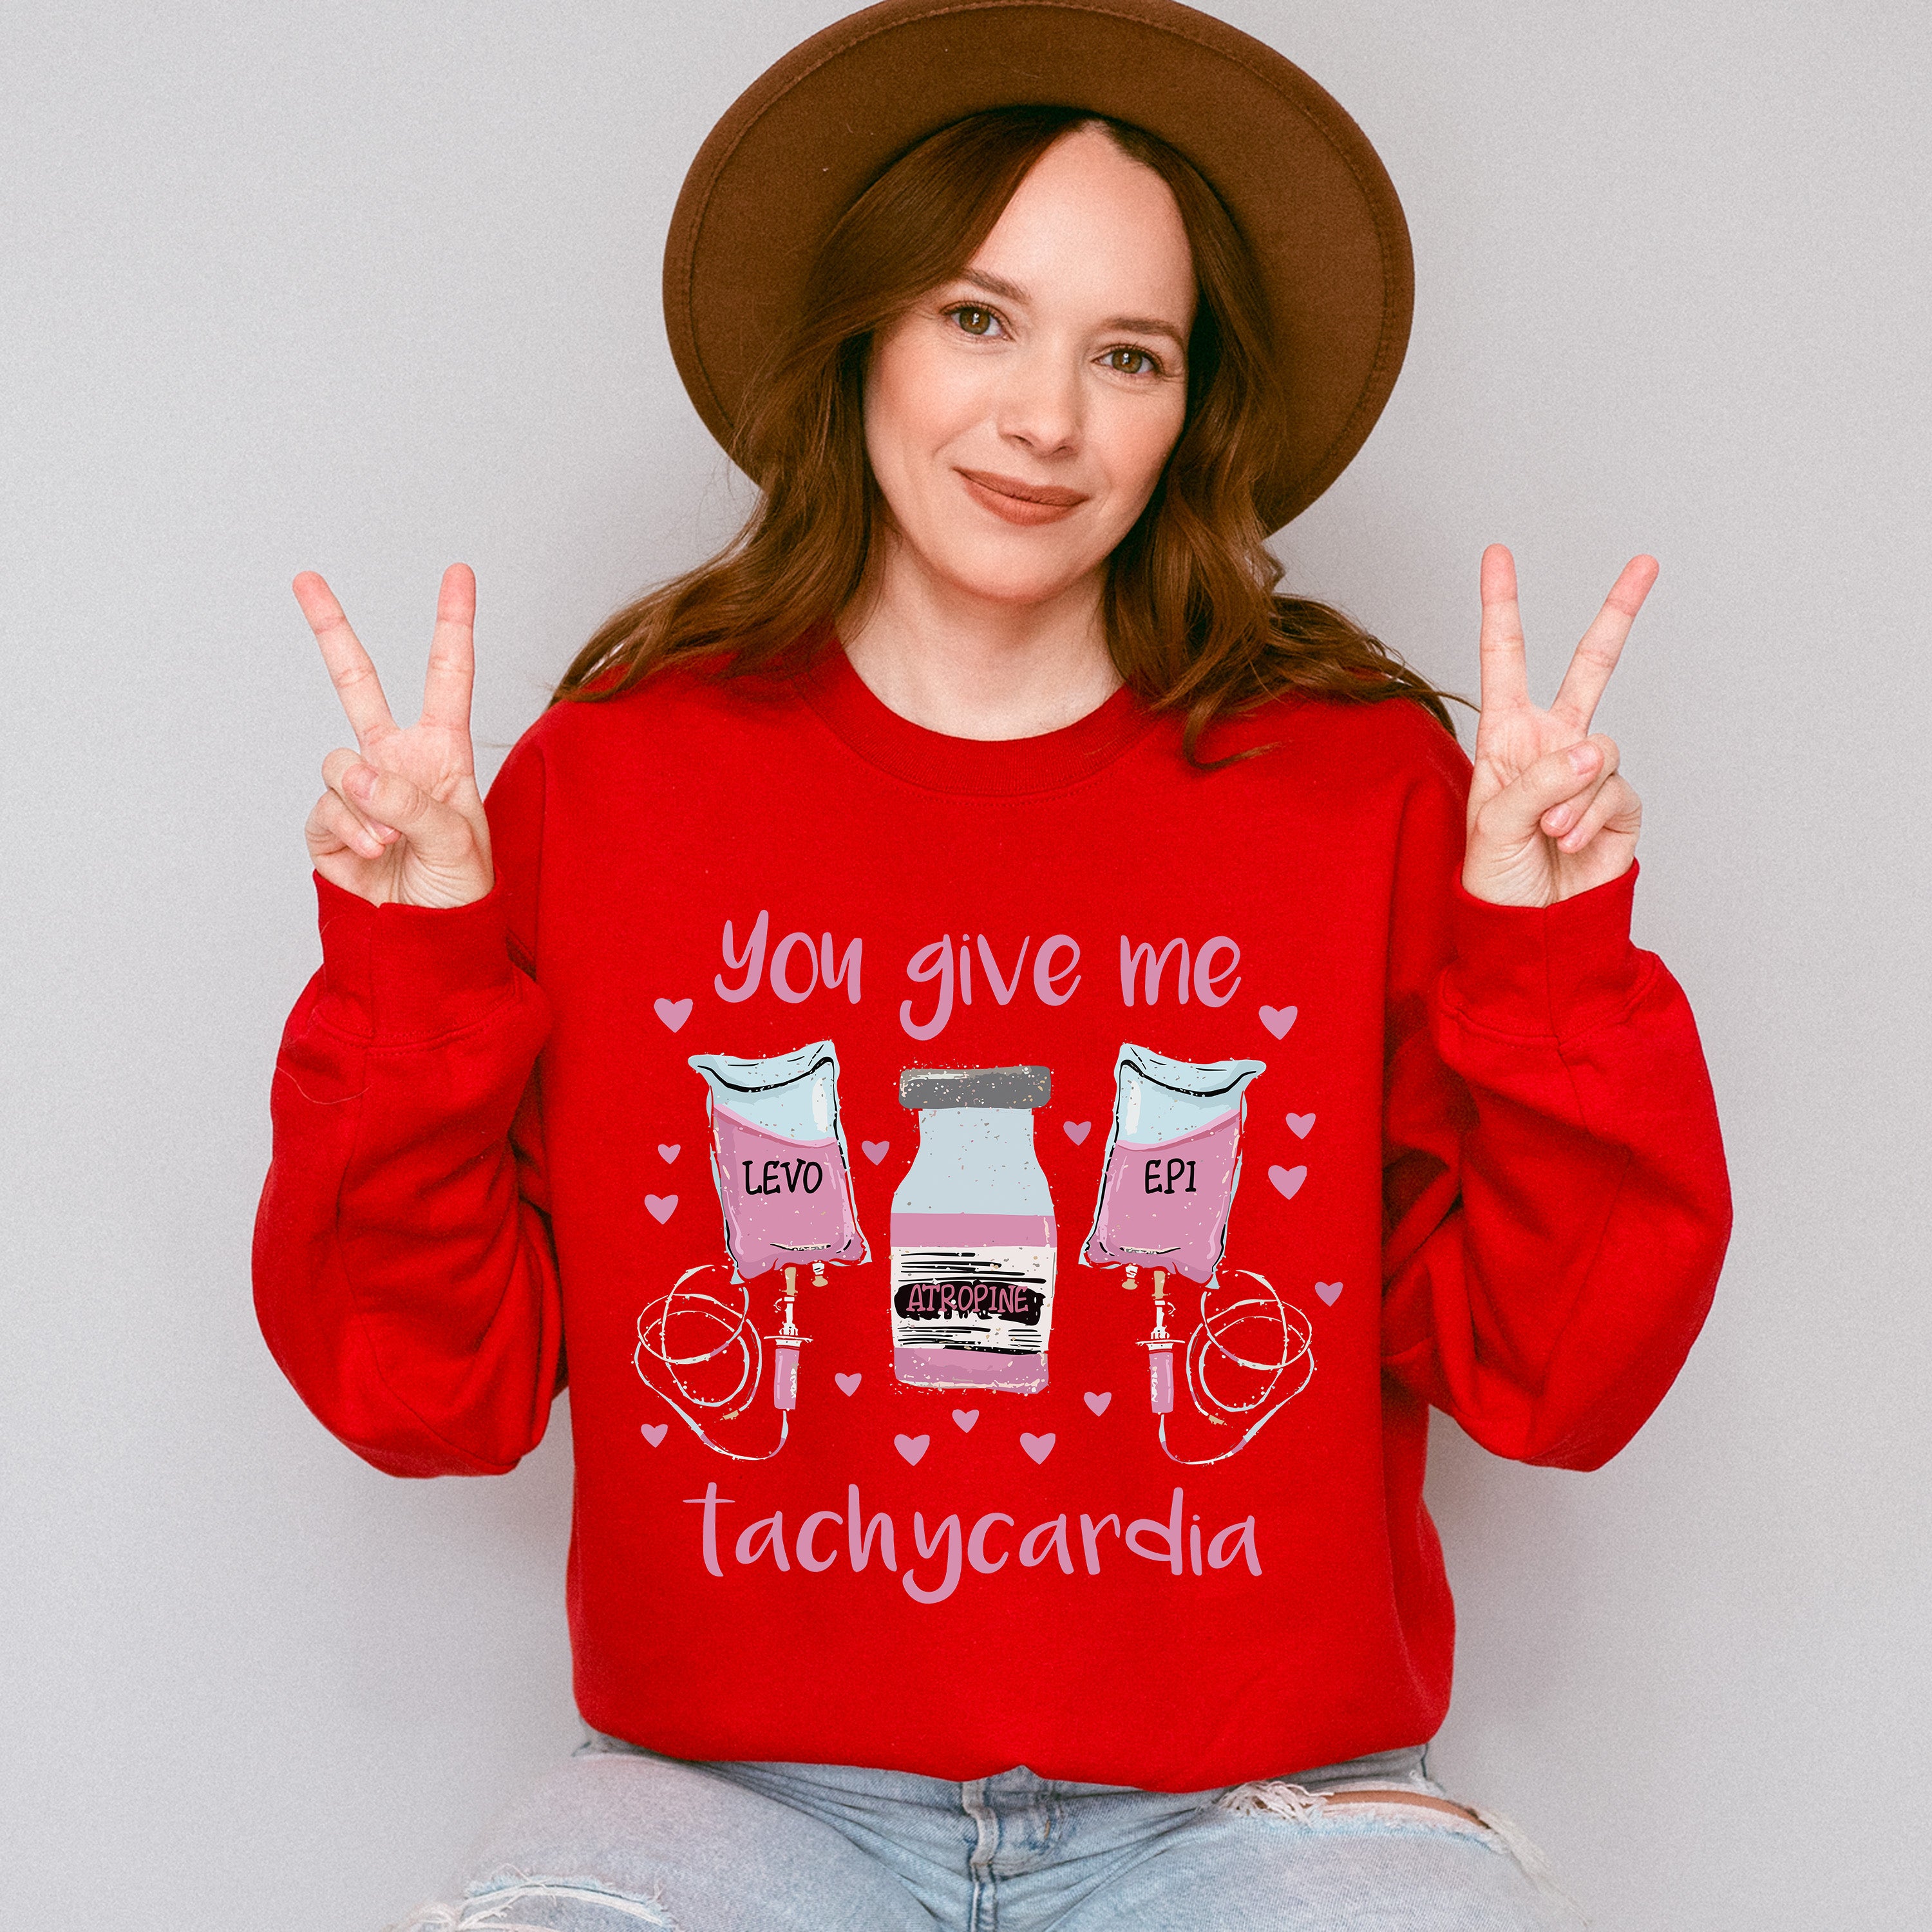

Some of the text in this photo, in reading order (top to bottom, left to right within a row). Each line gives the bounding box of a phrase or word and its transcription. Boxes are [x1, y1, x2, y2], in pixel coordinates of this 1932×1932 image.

[900, 933, 1082, 1041] give
[1121, 934, 1242, 1008] me
[742, 1158, 823, 1195] LEVO
[1144, 1158, 1197, 1195] EPI
[905, 1283, 1029, 1313] ATROPINE
[683, 1482, 1263, 1604] tachycardia
